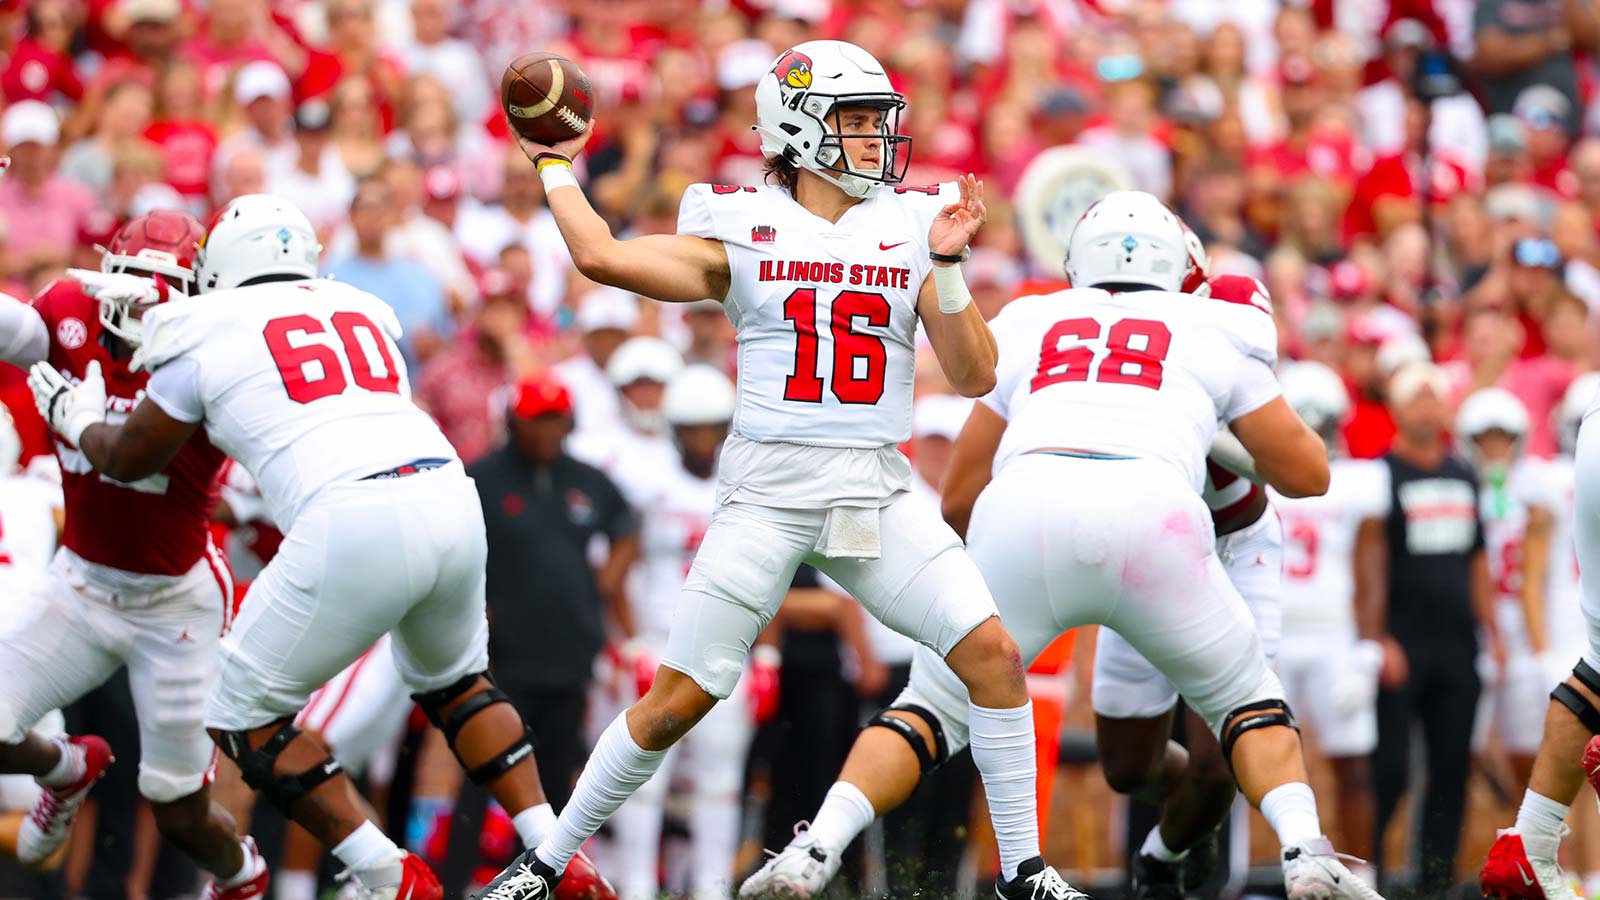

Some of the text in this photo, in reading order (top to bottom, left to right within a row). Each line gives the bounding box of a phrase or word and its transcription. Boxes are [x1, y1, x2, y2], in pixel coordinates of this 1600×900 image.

[759, 260, 910, 289] ILLINOIS STATE
[262, 311, 401, 405] 60
[783, 287, 891, 405] 16
[1030, 316, 1172, 394] 68
